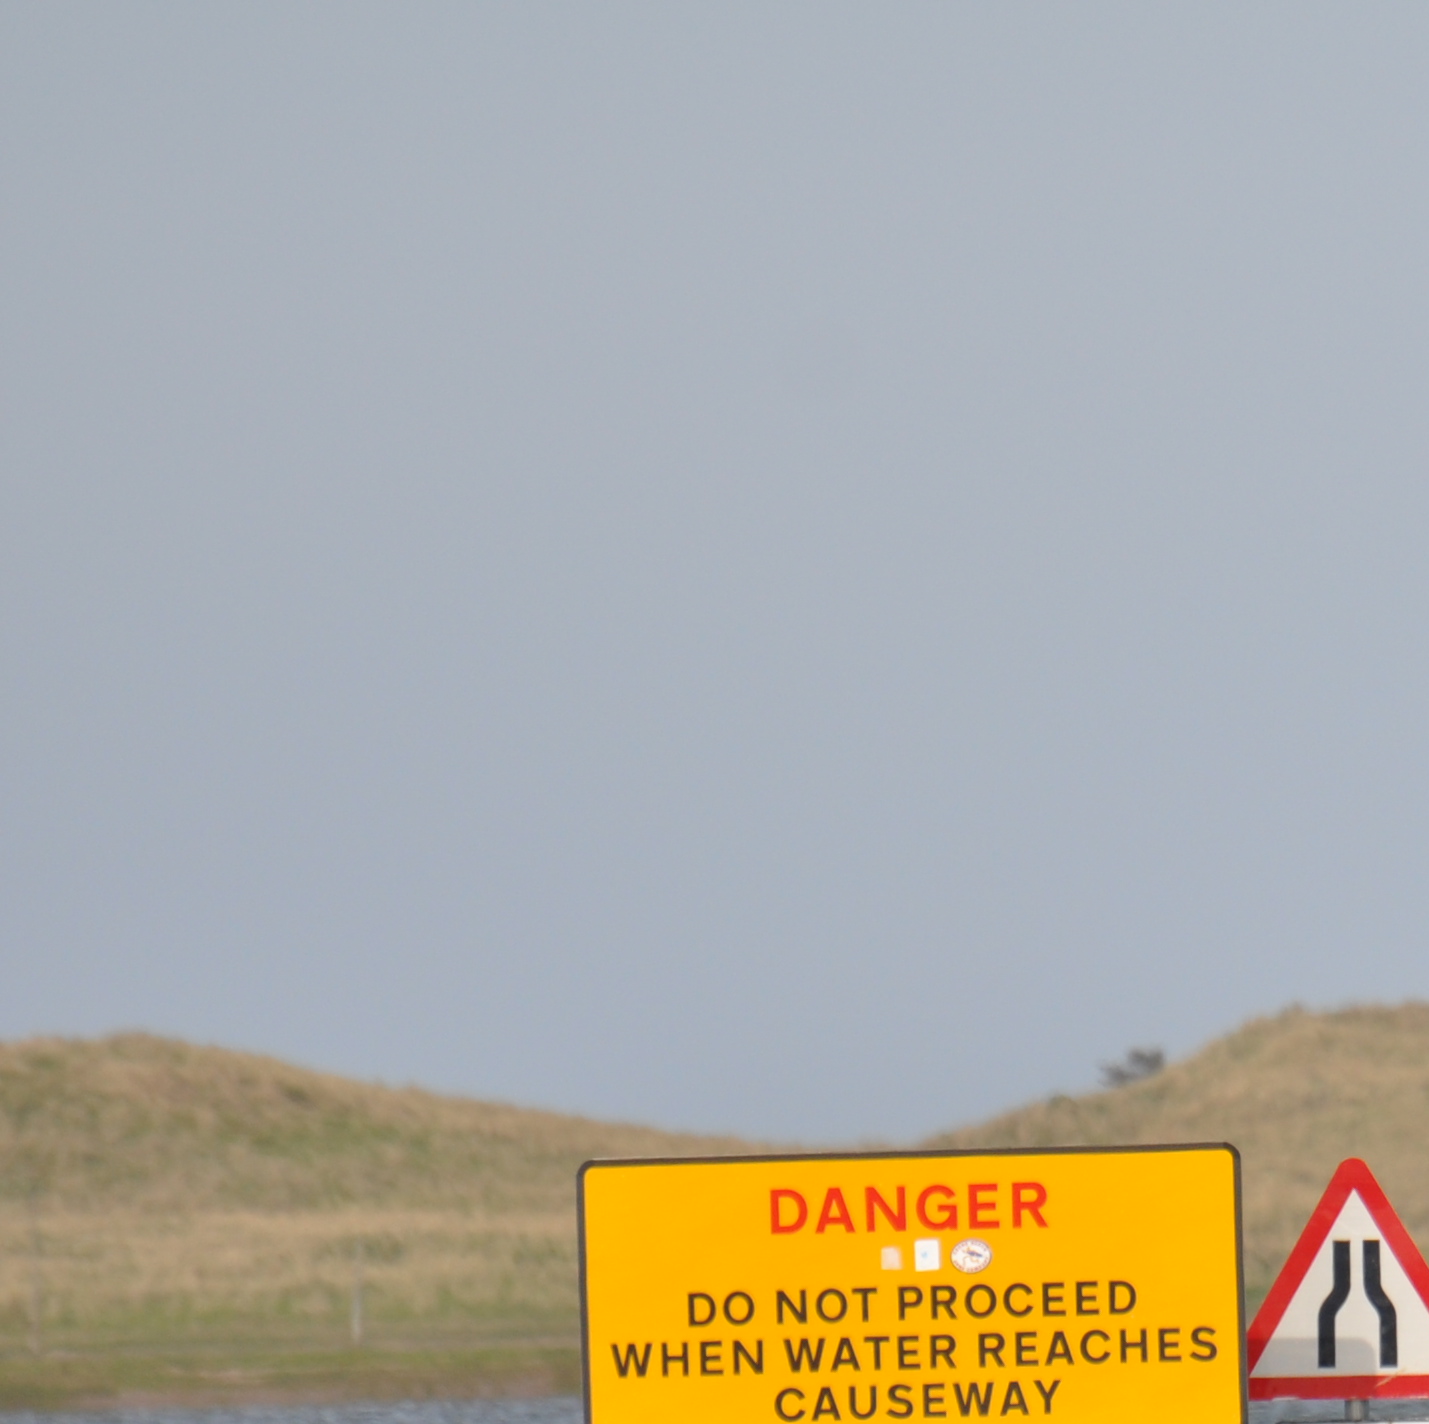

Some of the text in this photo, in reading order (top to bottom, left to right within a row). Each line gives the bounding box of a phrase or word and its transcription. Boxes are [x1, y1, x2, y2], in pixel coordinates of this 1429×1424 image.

[769, 1181, 1049, 1235] DANGER
[687, 1280, 1137, 1327] DO NOT PROCEED
[611, 1326, 1218, 1378] WHEN WATER REACHES
[774, 1379, 1061, 1423] CAUSEWAY
